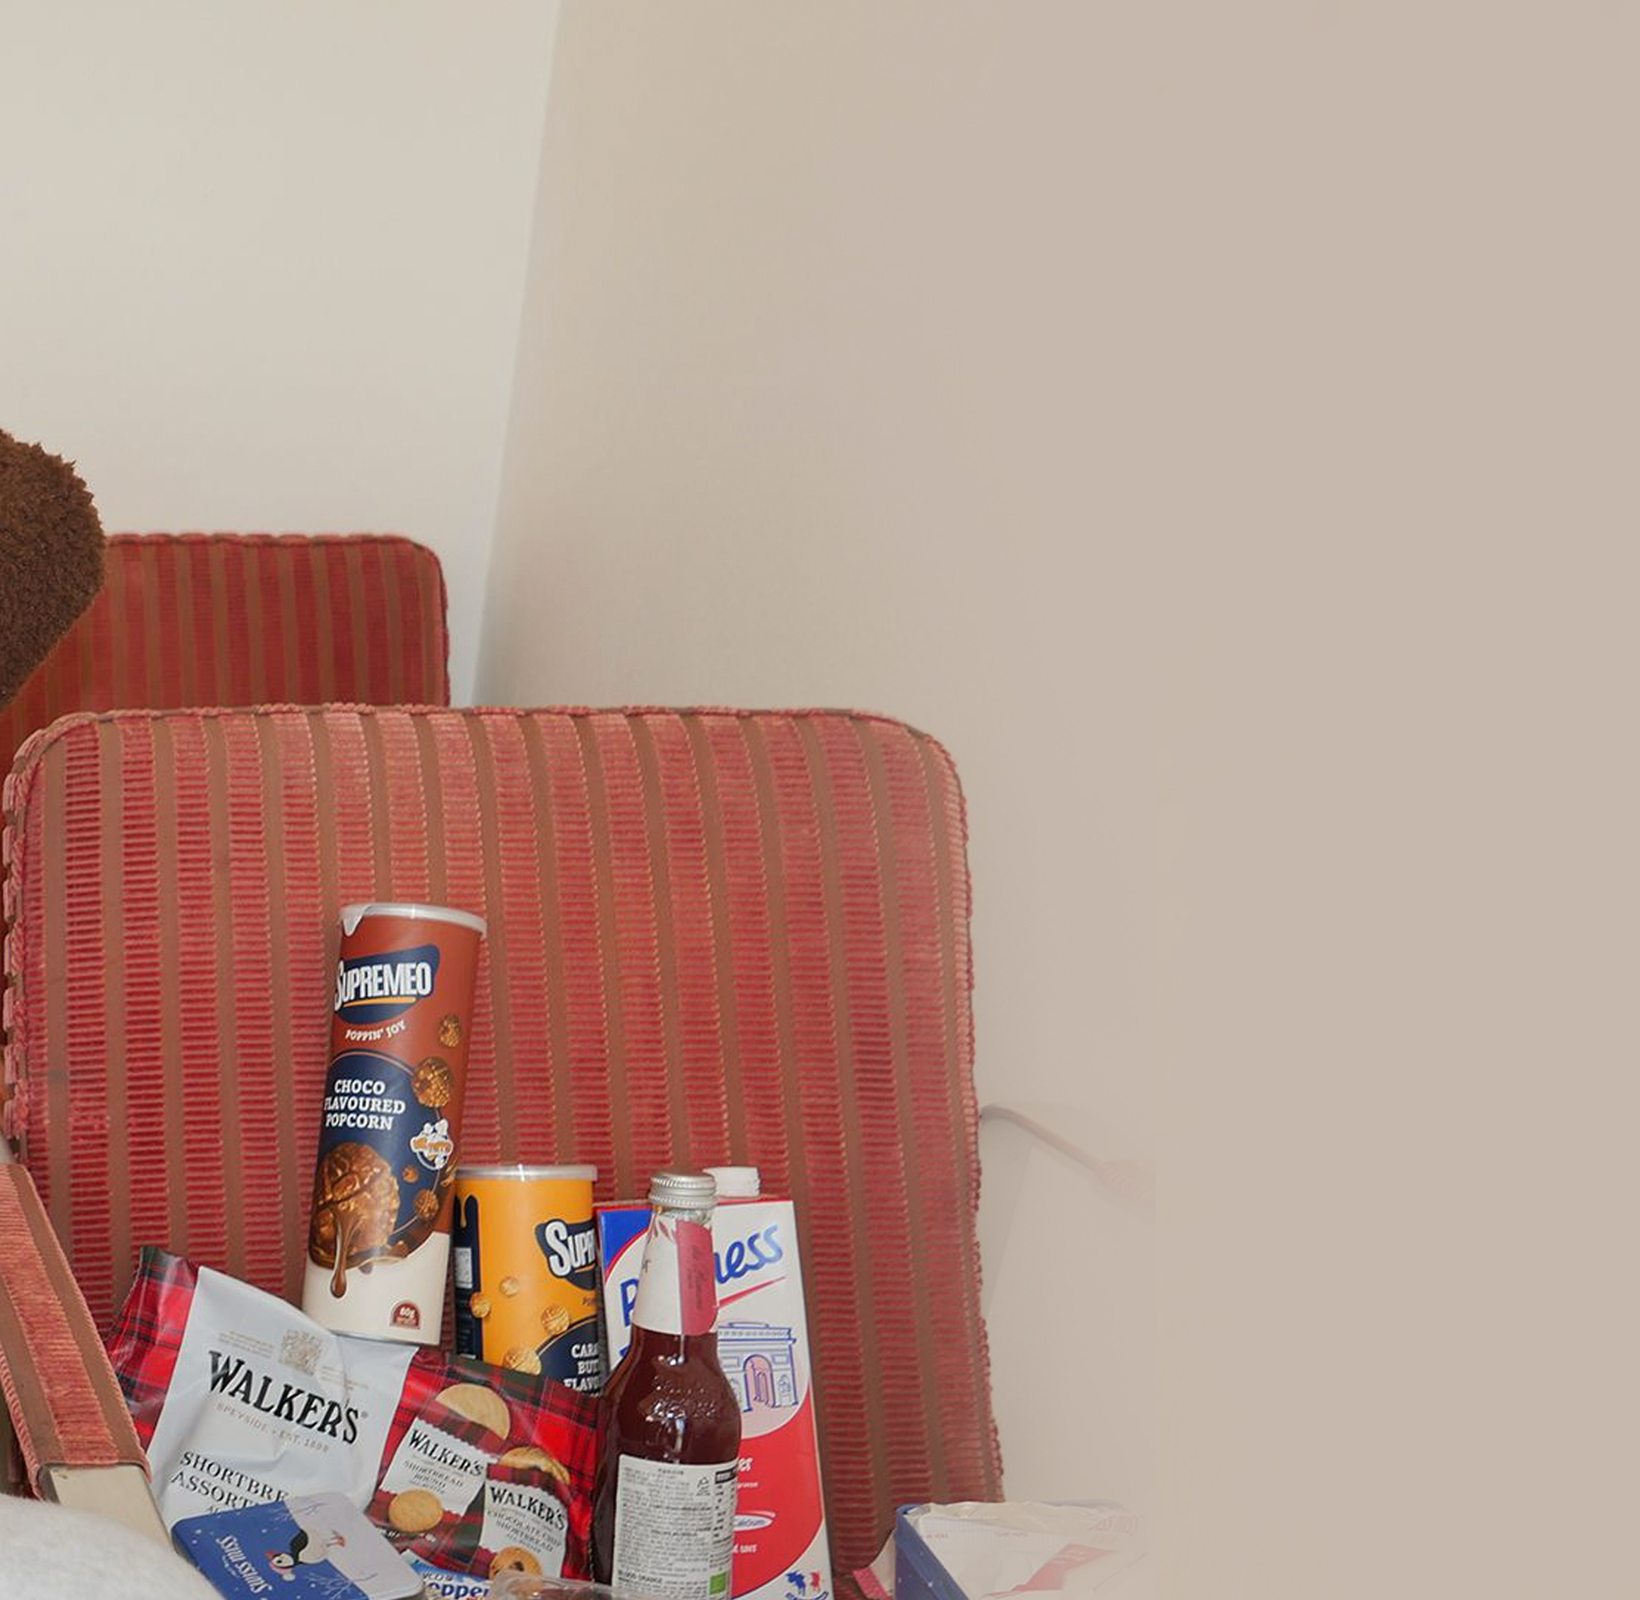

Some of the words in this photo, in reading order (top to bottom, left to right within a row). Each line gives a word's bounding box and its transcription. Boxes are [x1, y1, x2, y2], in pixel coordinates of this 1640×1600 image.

[385, 1019, 406, 1038] JOY
[323, 1096, 407, 1115] FLAVOURED
[334, 1079, 386, 1095] CHOCO
[325, 1112, 394, 1130] POPCORN
[545, 1221, 596, 1276] SUPR
[208, 1351, 358, 1444] WALKER'S
[409, 1429, 483, 1476] WALKER'S
[180, 1451, 288, 1502] SHORTBRE
[490, 1487, 565, 1530] WALKER'S
